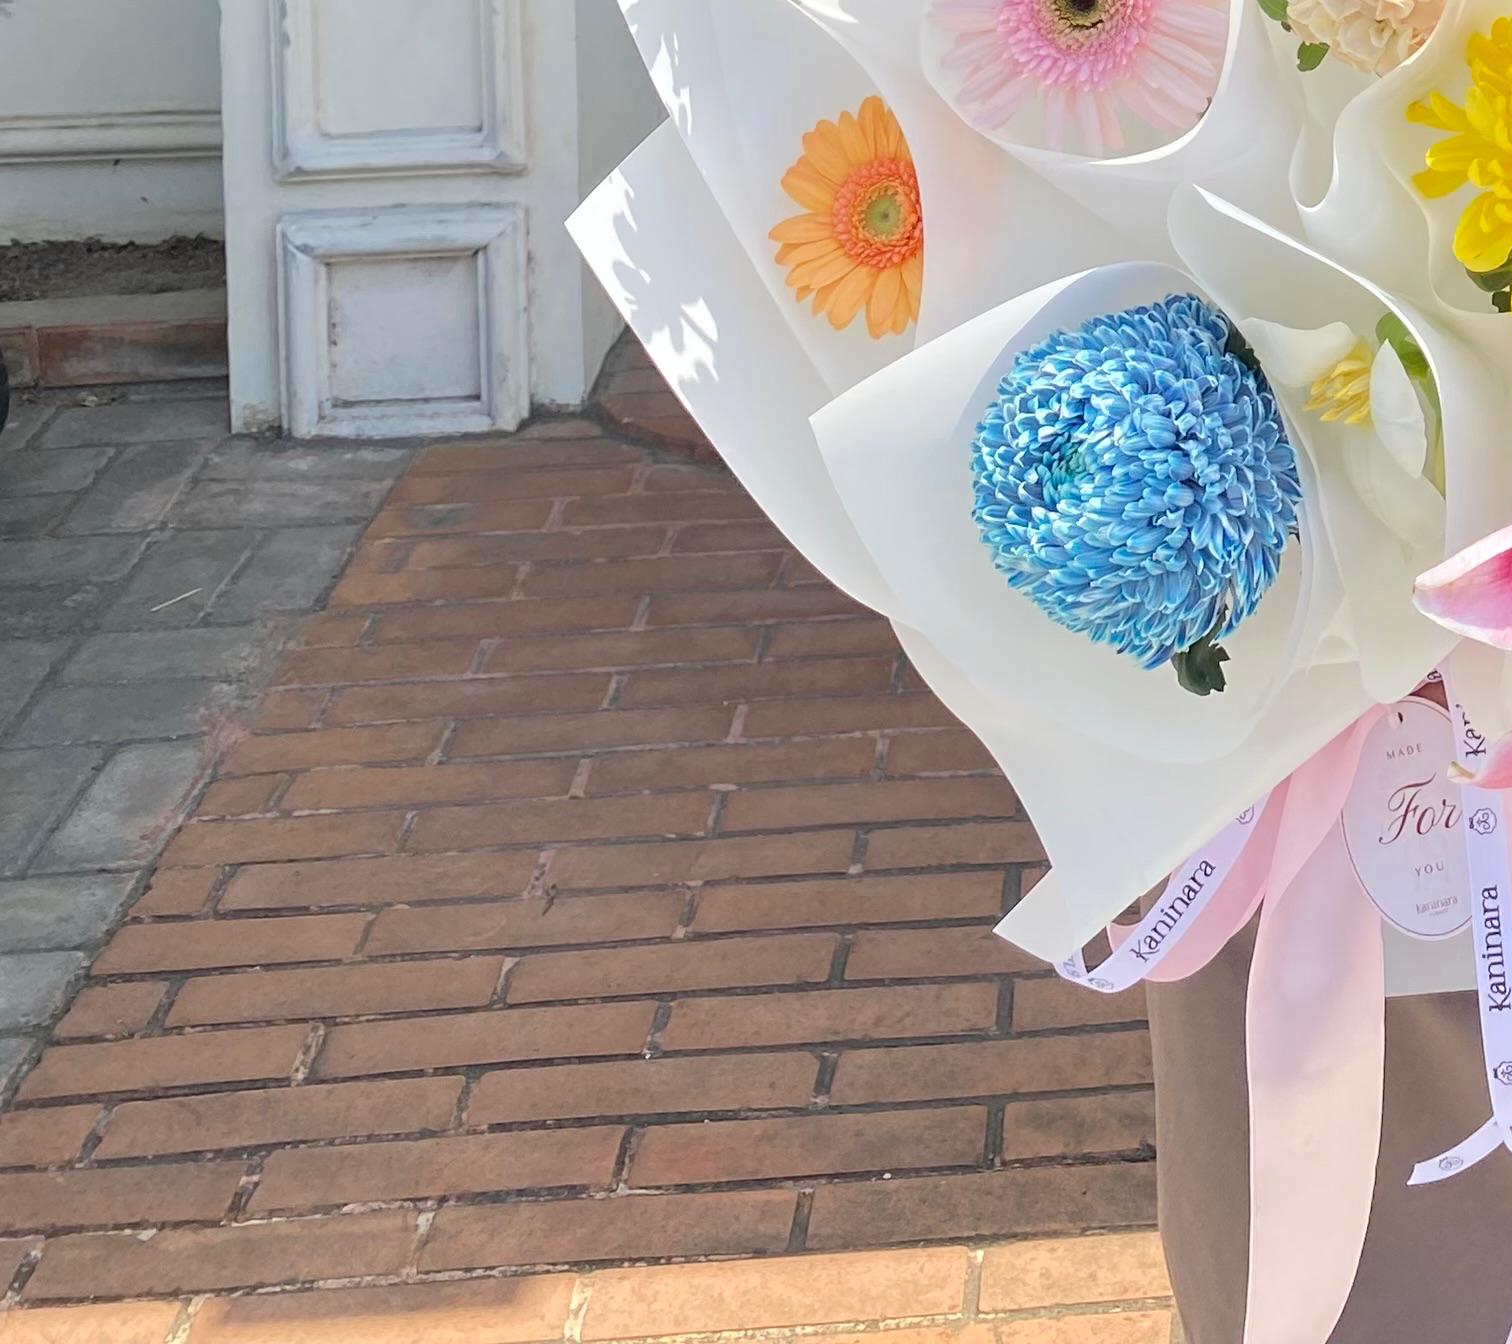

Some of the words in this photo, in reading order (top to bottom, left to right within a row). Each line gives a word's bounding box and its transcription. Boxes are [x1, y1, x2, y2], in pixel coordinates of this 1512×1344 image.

[1386, 743, 1424, 760] MADE
[1379, 772, 1463, 844] For
[1414, 862, 1445, 876] YOU
[1130, 859, 1216, 963] Kaninara
[1482, 884, 1511, 1012] Kaninara
